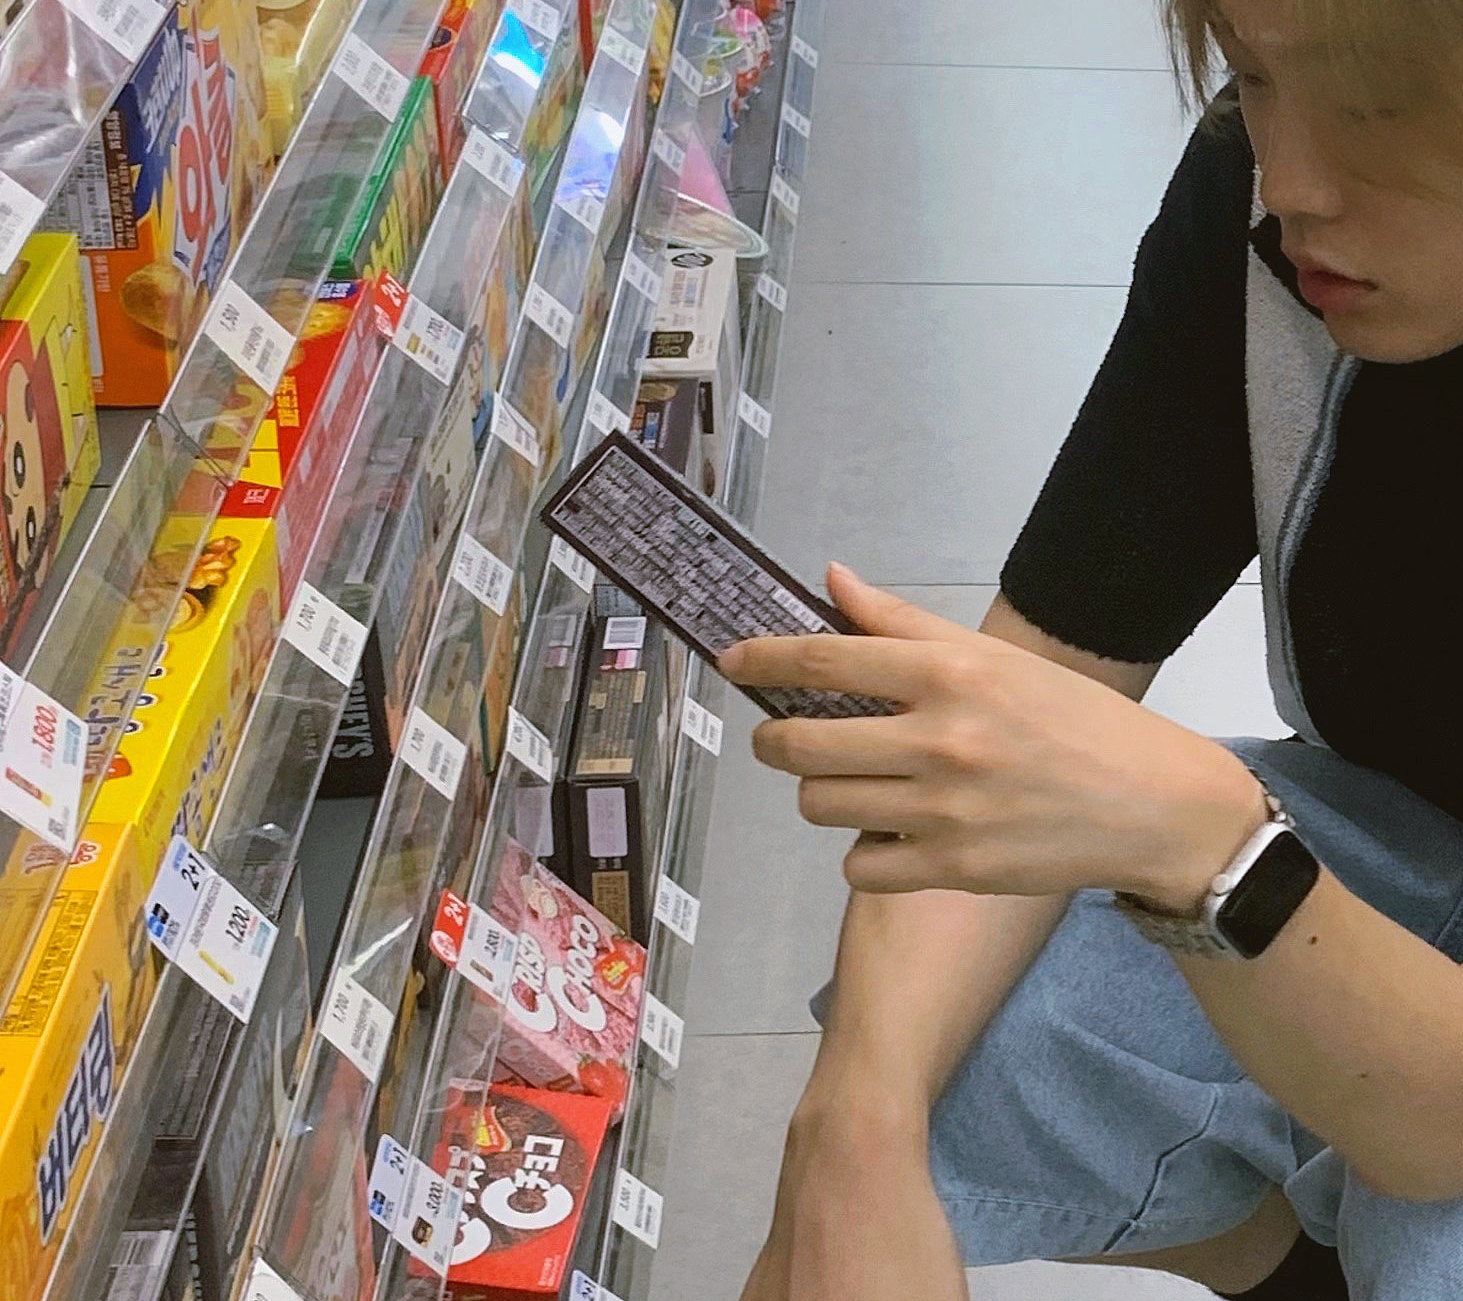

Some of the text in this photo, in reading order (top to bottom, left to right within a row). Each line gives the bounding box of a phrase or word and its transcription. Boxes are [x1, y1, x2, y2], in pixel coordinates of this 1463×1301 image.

[32, 705, 58, 755] 1,800
[179, 853, 212, 892] 2+1
[226, 905, 253, 952] 1,200
[441, 895, 469, 926] 2+1
[506, 936, 557, 1034] CRISP
[546, 914, 608, 1031] CHOCO
[388, 1145, 408, 1173] 2+1
[425, 1178, 445, 1220] 3,000
